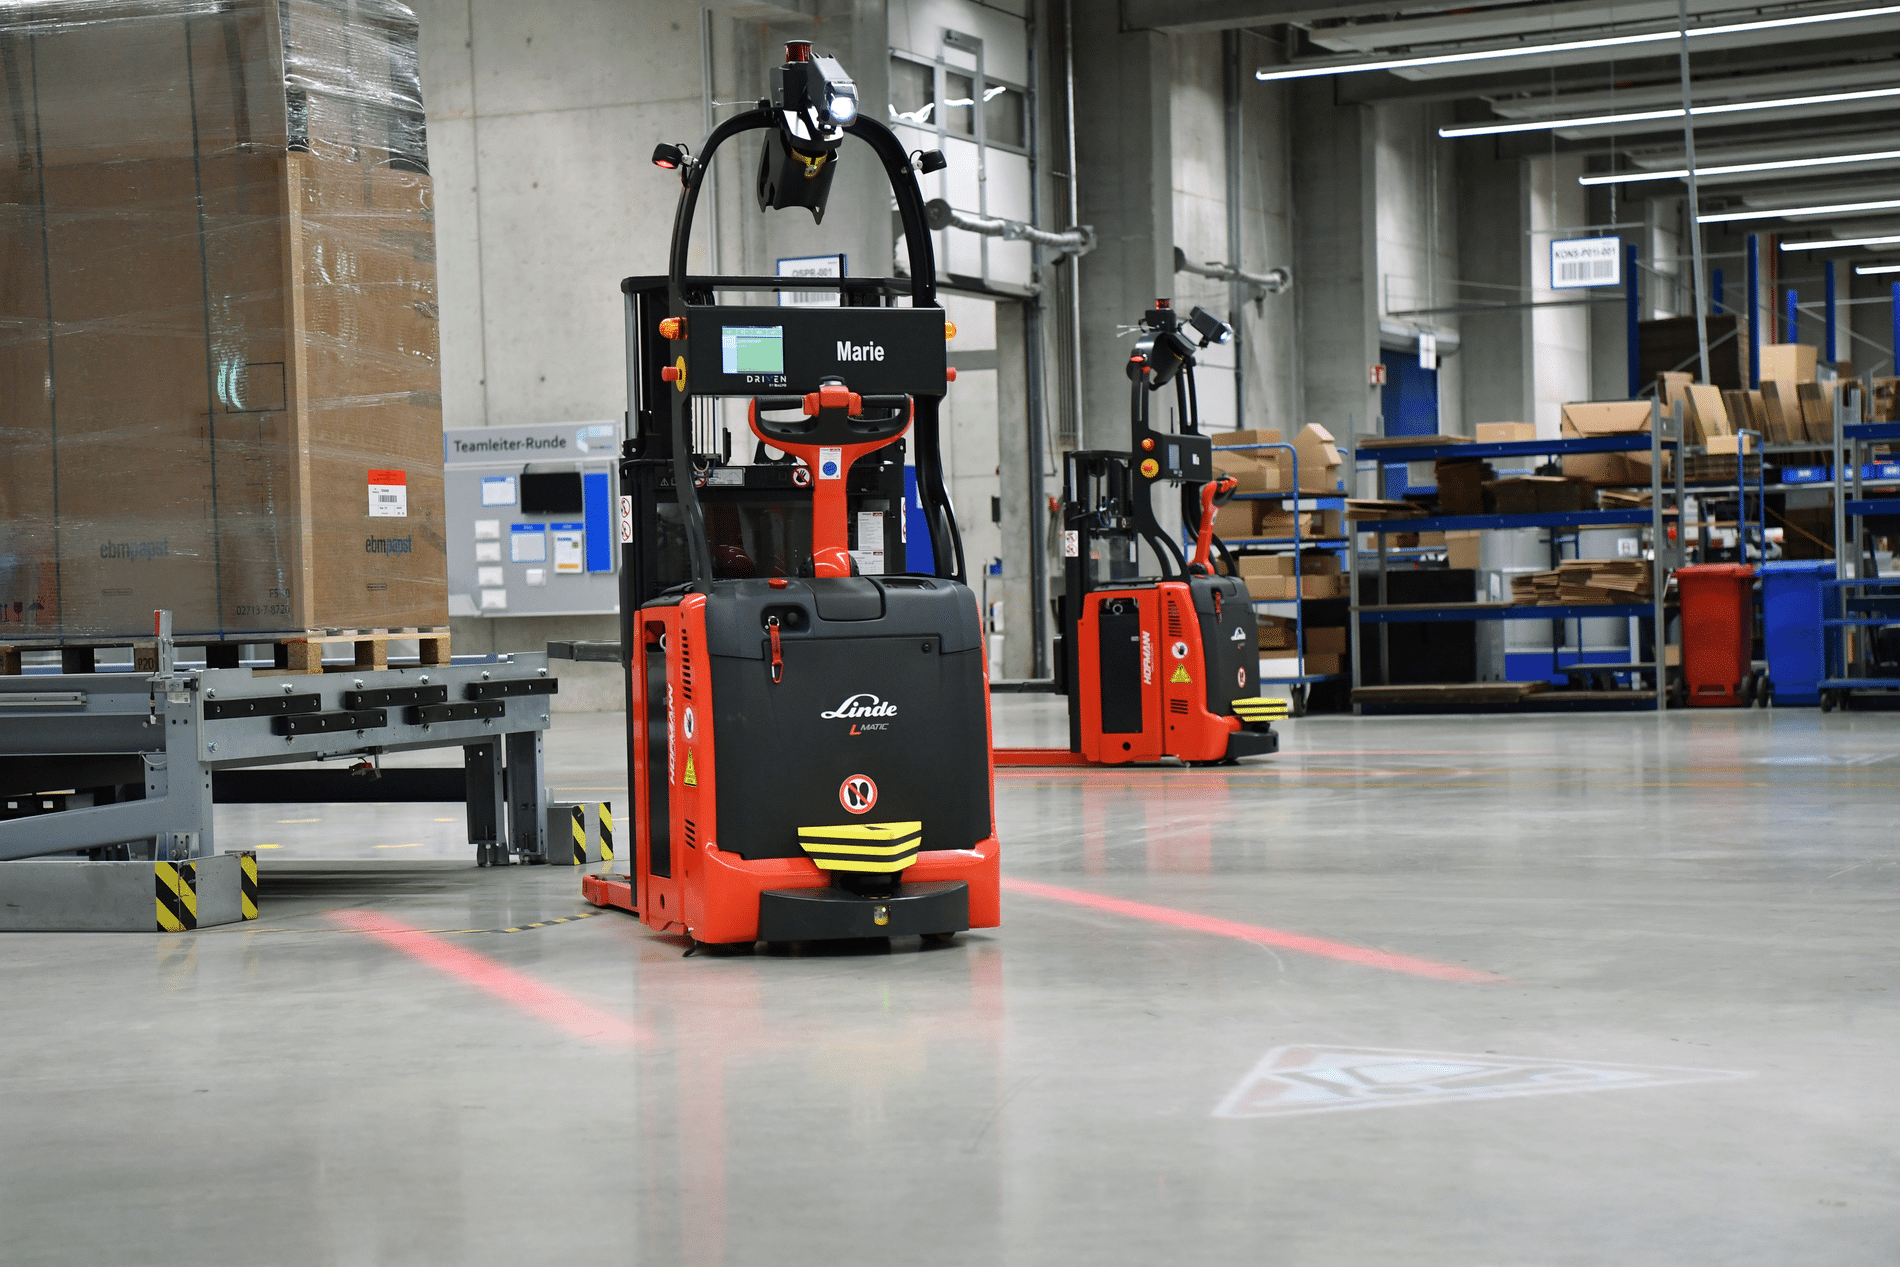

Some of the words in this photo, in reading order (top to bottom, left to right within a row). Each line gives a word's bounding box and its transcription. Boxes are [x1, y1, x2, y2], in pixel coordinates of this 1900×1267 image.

[836, 341, 885, 362] Marie
[746, 375, 787, 383] DRIVEN
[454, 435, 567, 453] Teamleiter-Runde
[100, 537, 169, 562] ebmpapst
[365, 534, 413, 558] ebmpapst
[269, 588, 291, 599] FS0
[820, 693, 898, 719] Linde
[860, 723, 890, 731] MATIC
